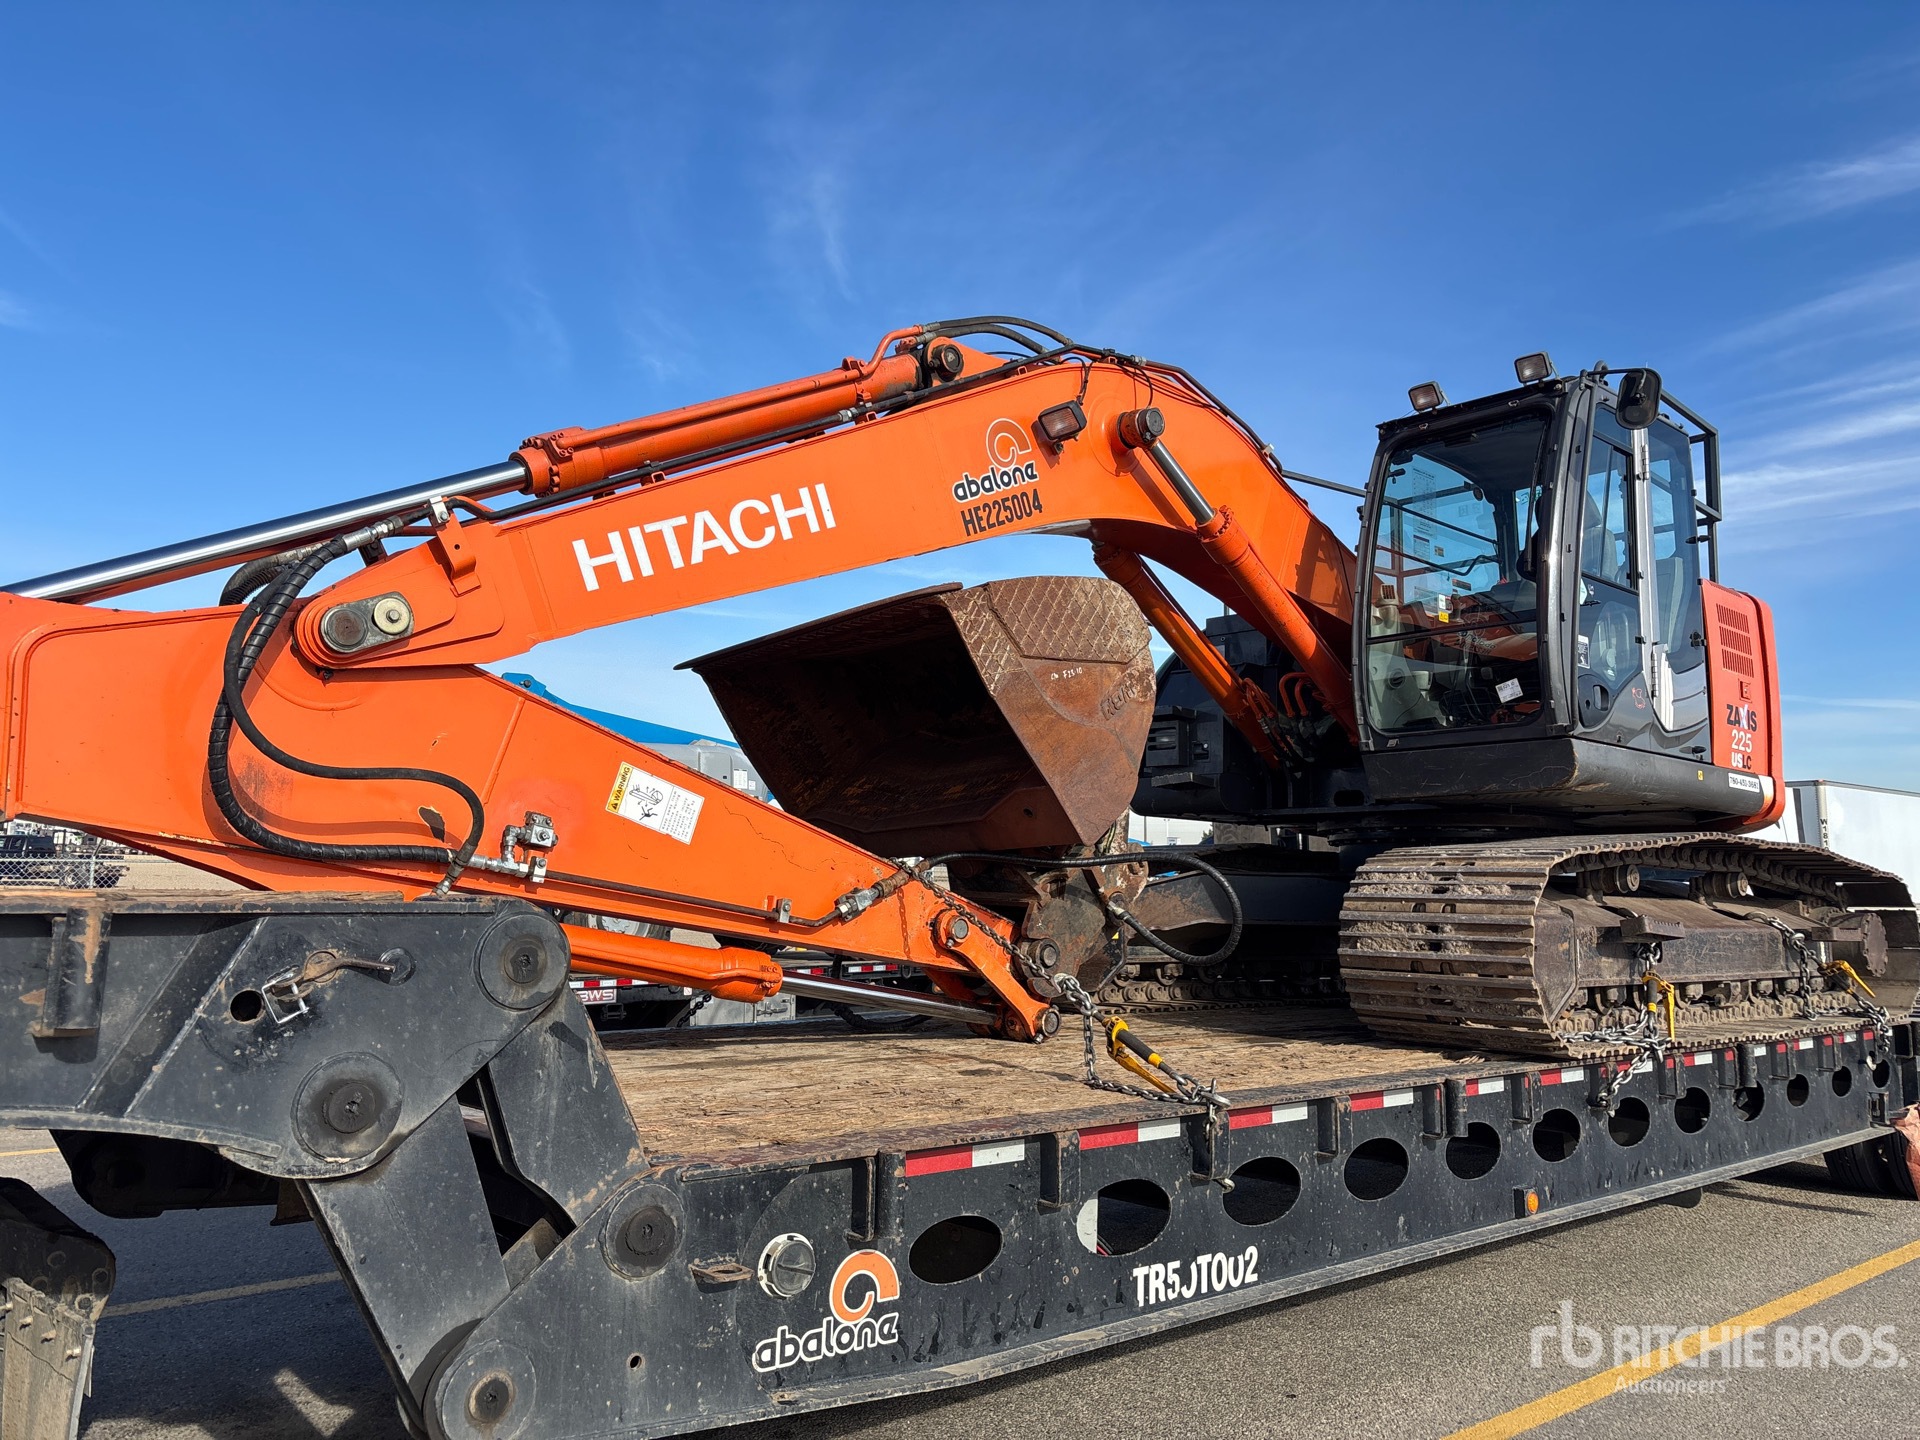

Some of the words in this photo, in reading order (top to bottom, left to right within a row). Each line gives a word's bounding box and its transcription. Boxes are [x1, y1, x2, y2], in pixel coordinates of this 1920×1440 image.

[953, 461, 1039, 502] abalone
[960, 488, 1043, 537] HE225004
[572, 483, 837, 592] HITACHI
[1726, 704, 1757, 732] ZAXIS
[1731, 729, 1753, 753] 225
[1731, 751, 1752, 770] USLC
[614, 766, 631, 801] WARNING
[752, 1311, 900, 1374] abalone
